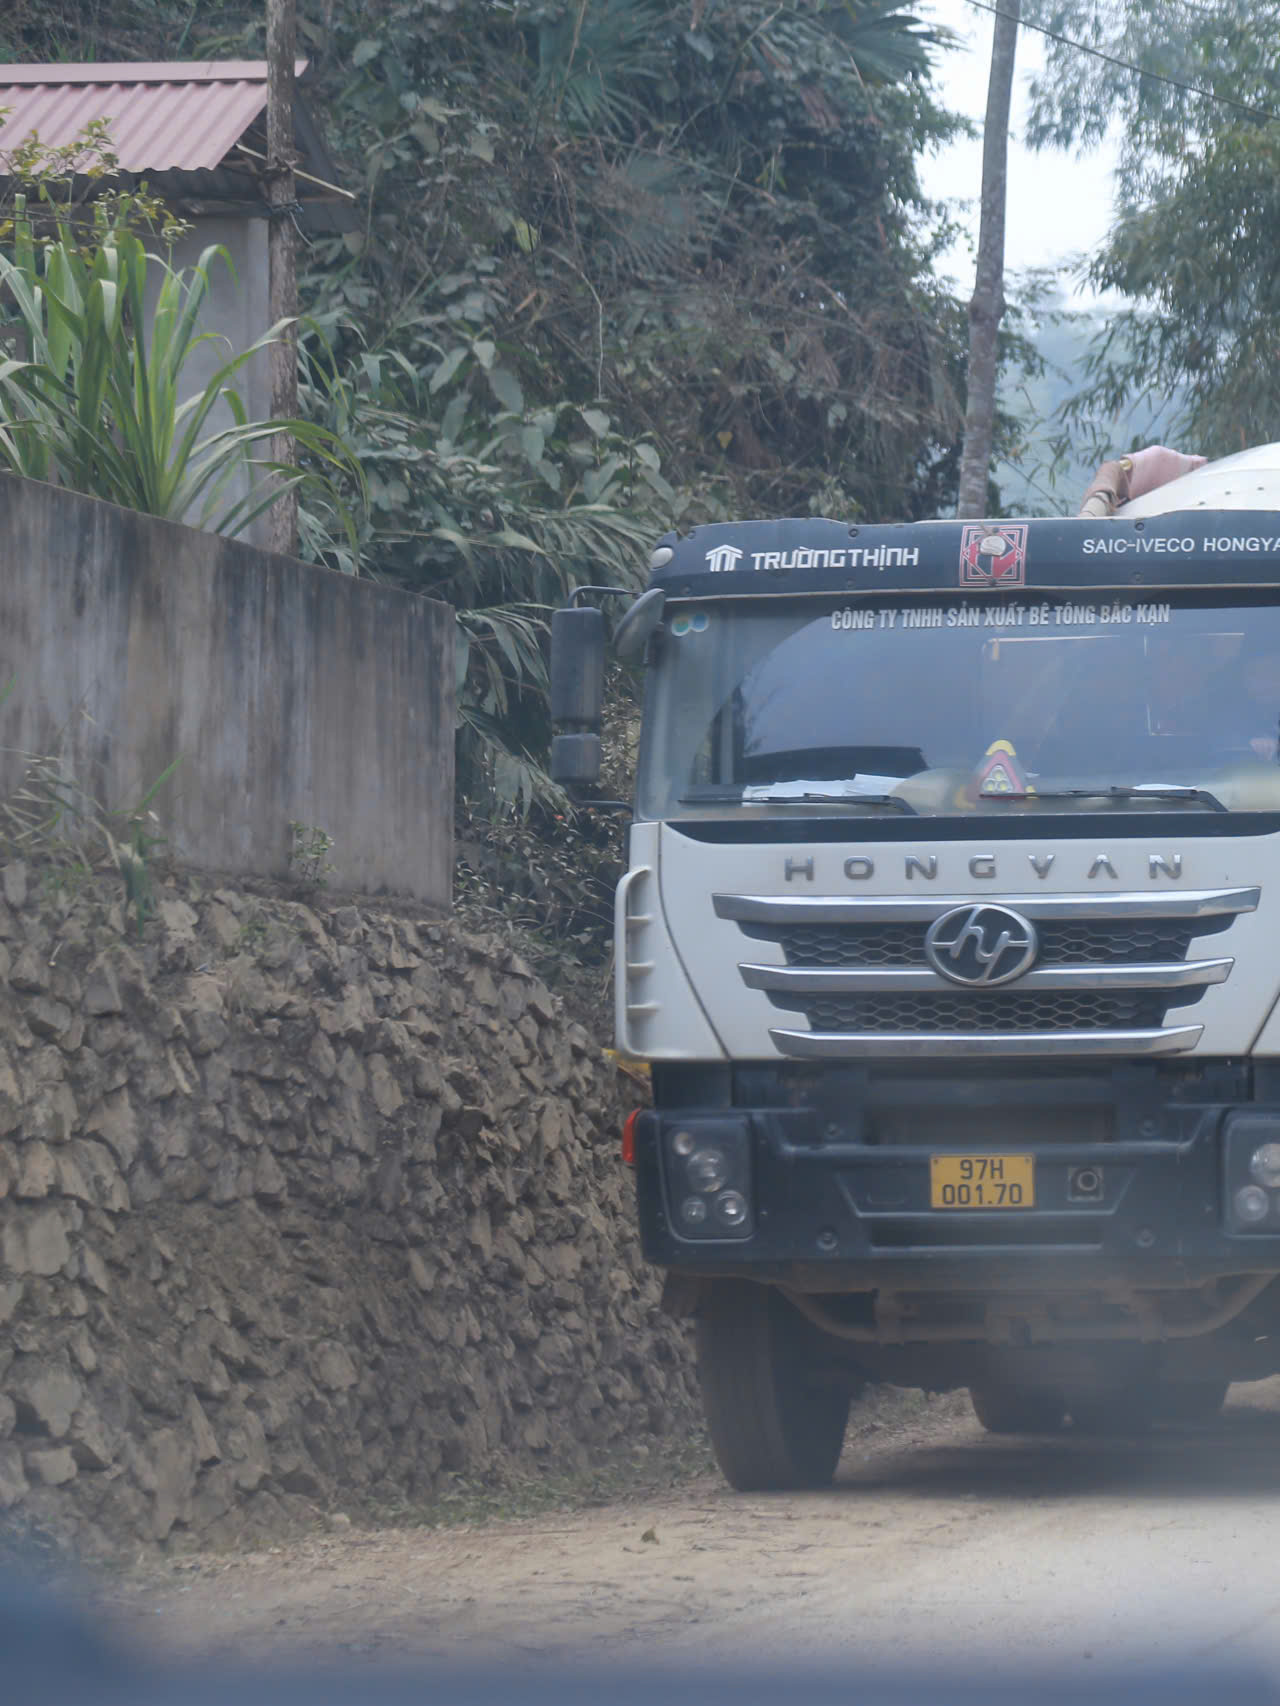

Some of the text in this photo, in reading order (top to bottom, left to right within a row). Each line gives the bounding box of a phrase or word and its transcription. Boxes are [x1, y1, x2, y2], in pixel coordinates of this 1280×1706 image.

[1082, 538, 1195, 554] SAIC-IVECO
[831, 597, 1170, 630] CÔNG TY TNHH SẢN XUẤT BÊ TÔNG BẮC KẠN
[784, 853, 1183, 881] HONGYAN
[959, 1159, 1004, 1180] 97H
[942, 1183, 1022, 1205] 001.70
